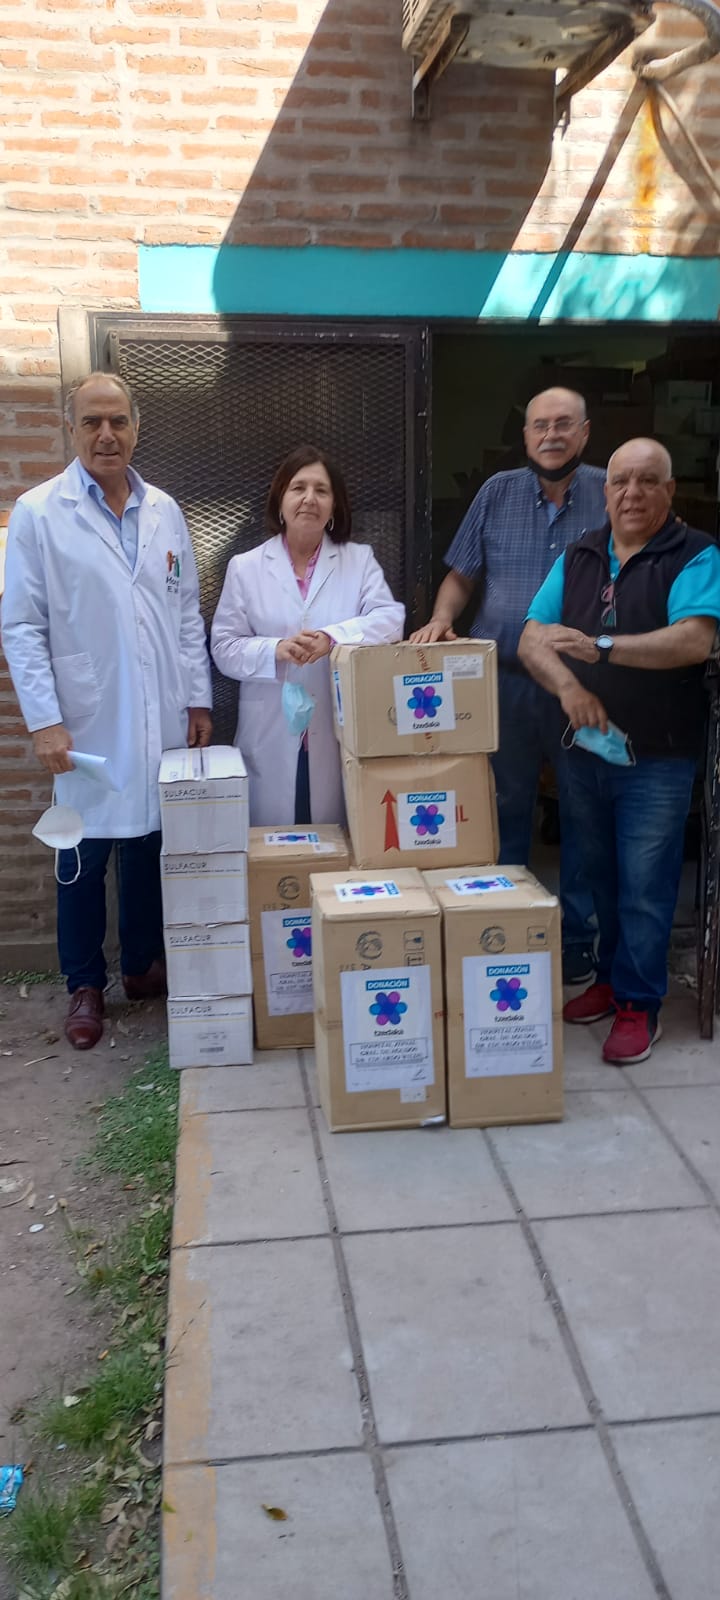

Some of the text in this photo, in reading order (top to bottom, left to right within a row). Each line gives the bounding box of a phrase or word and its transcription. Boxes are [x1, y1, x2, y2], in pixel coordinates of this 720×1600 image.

[405, 674, 442, 684] DONACIÓN
[164, 789, 207, 798] SULFACUR
[408, 794, 446, 803] DONACIÓN
[164, 862, 207, 871] SULFACUR
[169, 935, 211, 944] SULFACUR
[487, 965, 529, 976] DONACIÓN
[367, 979, 408, 989] DONACIÓN
[170, 1005, 211, 1015] SULFACUR
